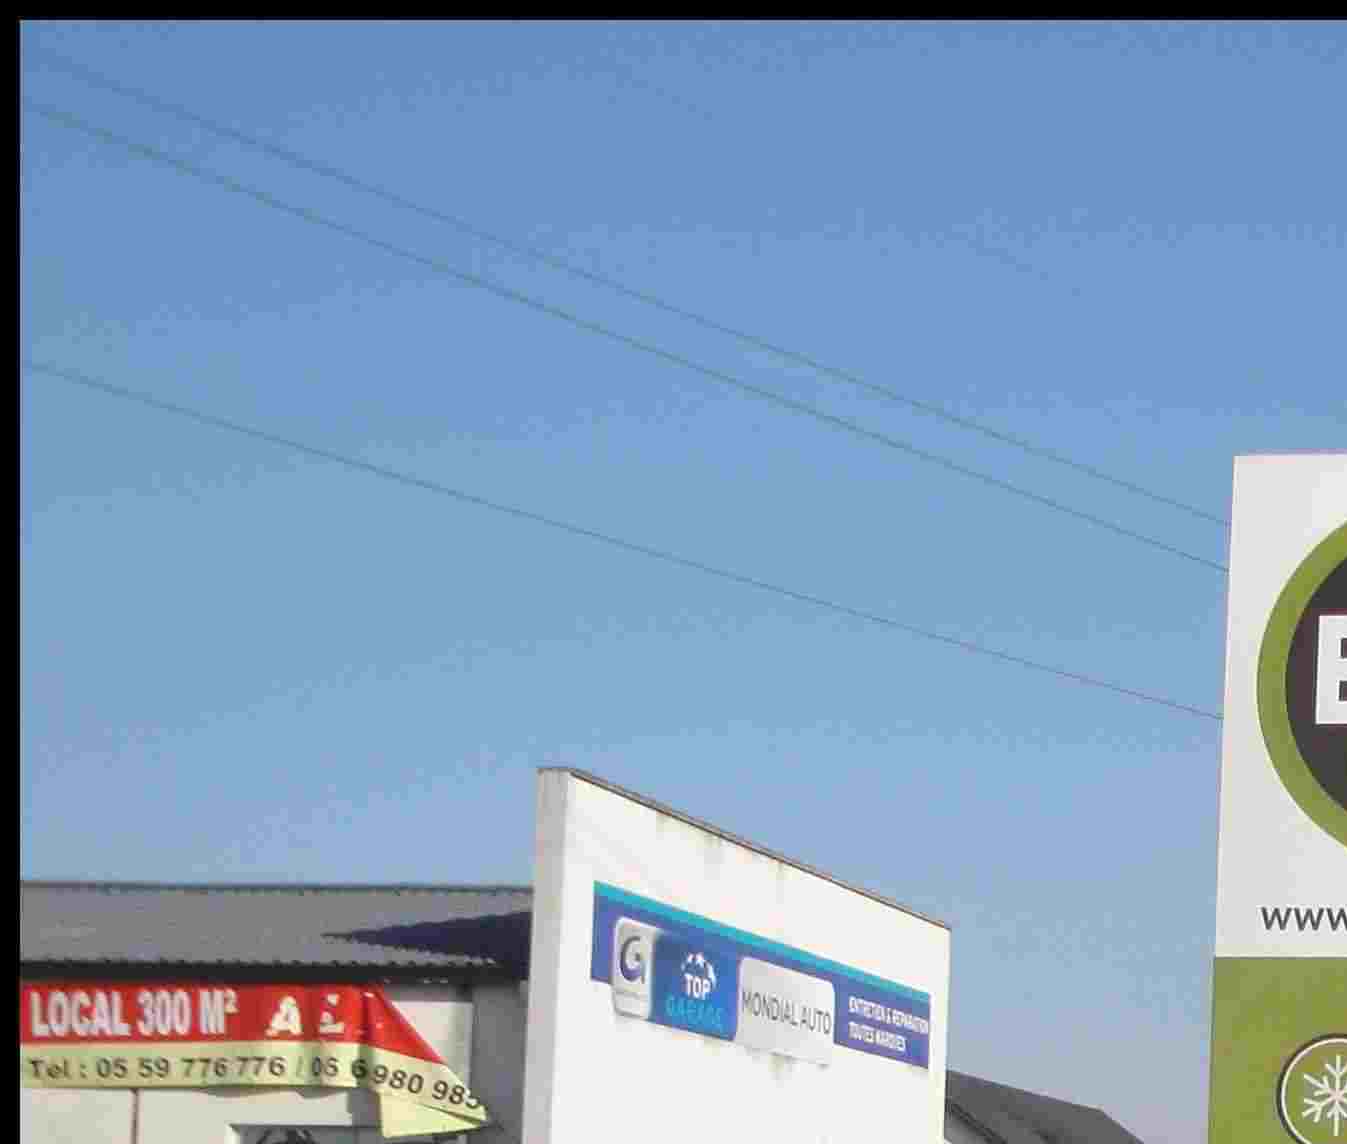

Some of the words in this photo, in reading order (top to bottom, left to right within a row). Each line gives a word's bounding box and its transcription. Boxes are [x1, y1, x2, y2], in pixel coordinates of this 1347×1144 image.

[684, 971, 712, 1000] TOP
[30, 990, 130, 1037] LOCAL
[137, 989, 191, 1036] 300
[742, 990, 798, 1026] MONDIAL
[800, 1007, 832, 1036] AUTO
[96, 1056, 128, 1079] 05
[137, 1056, 169, 1079] 59
[181, 1056, 227, 1079] 776
[234, 1056, 287, 1079] 776
